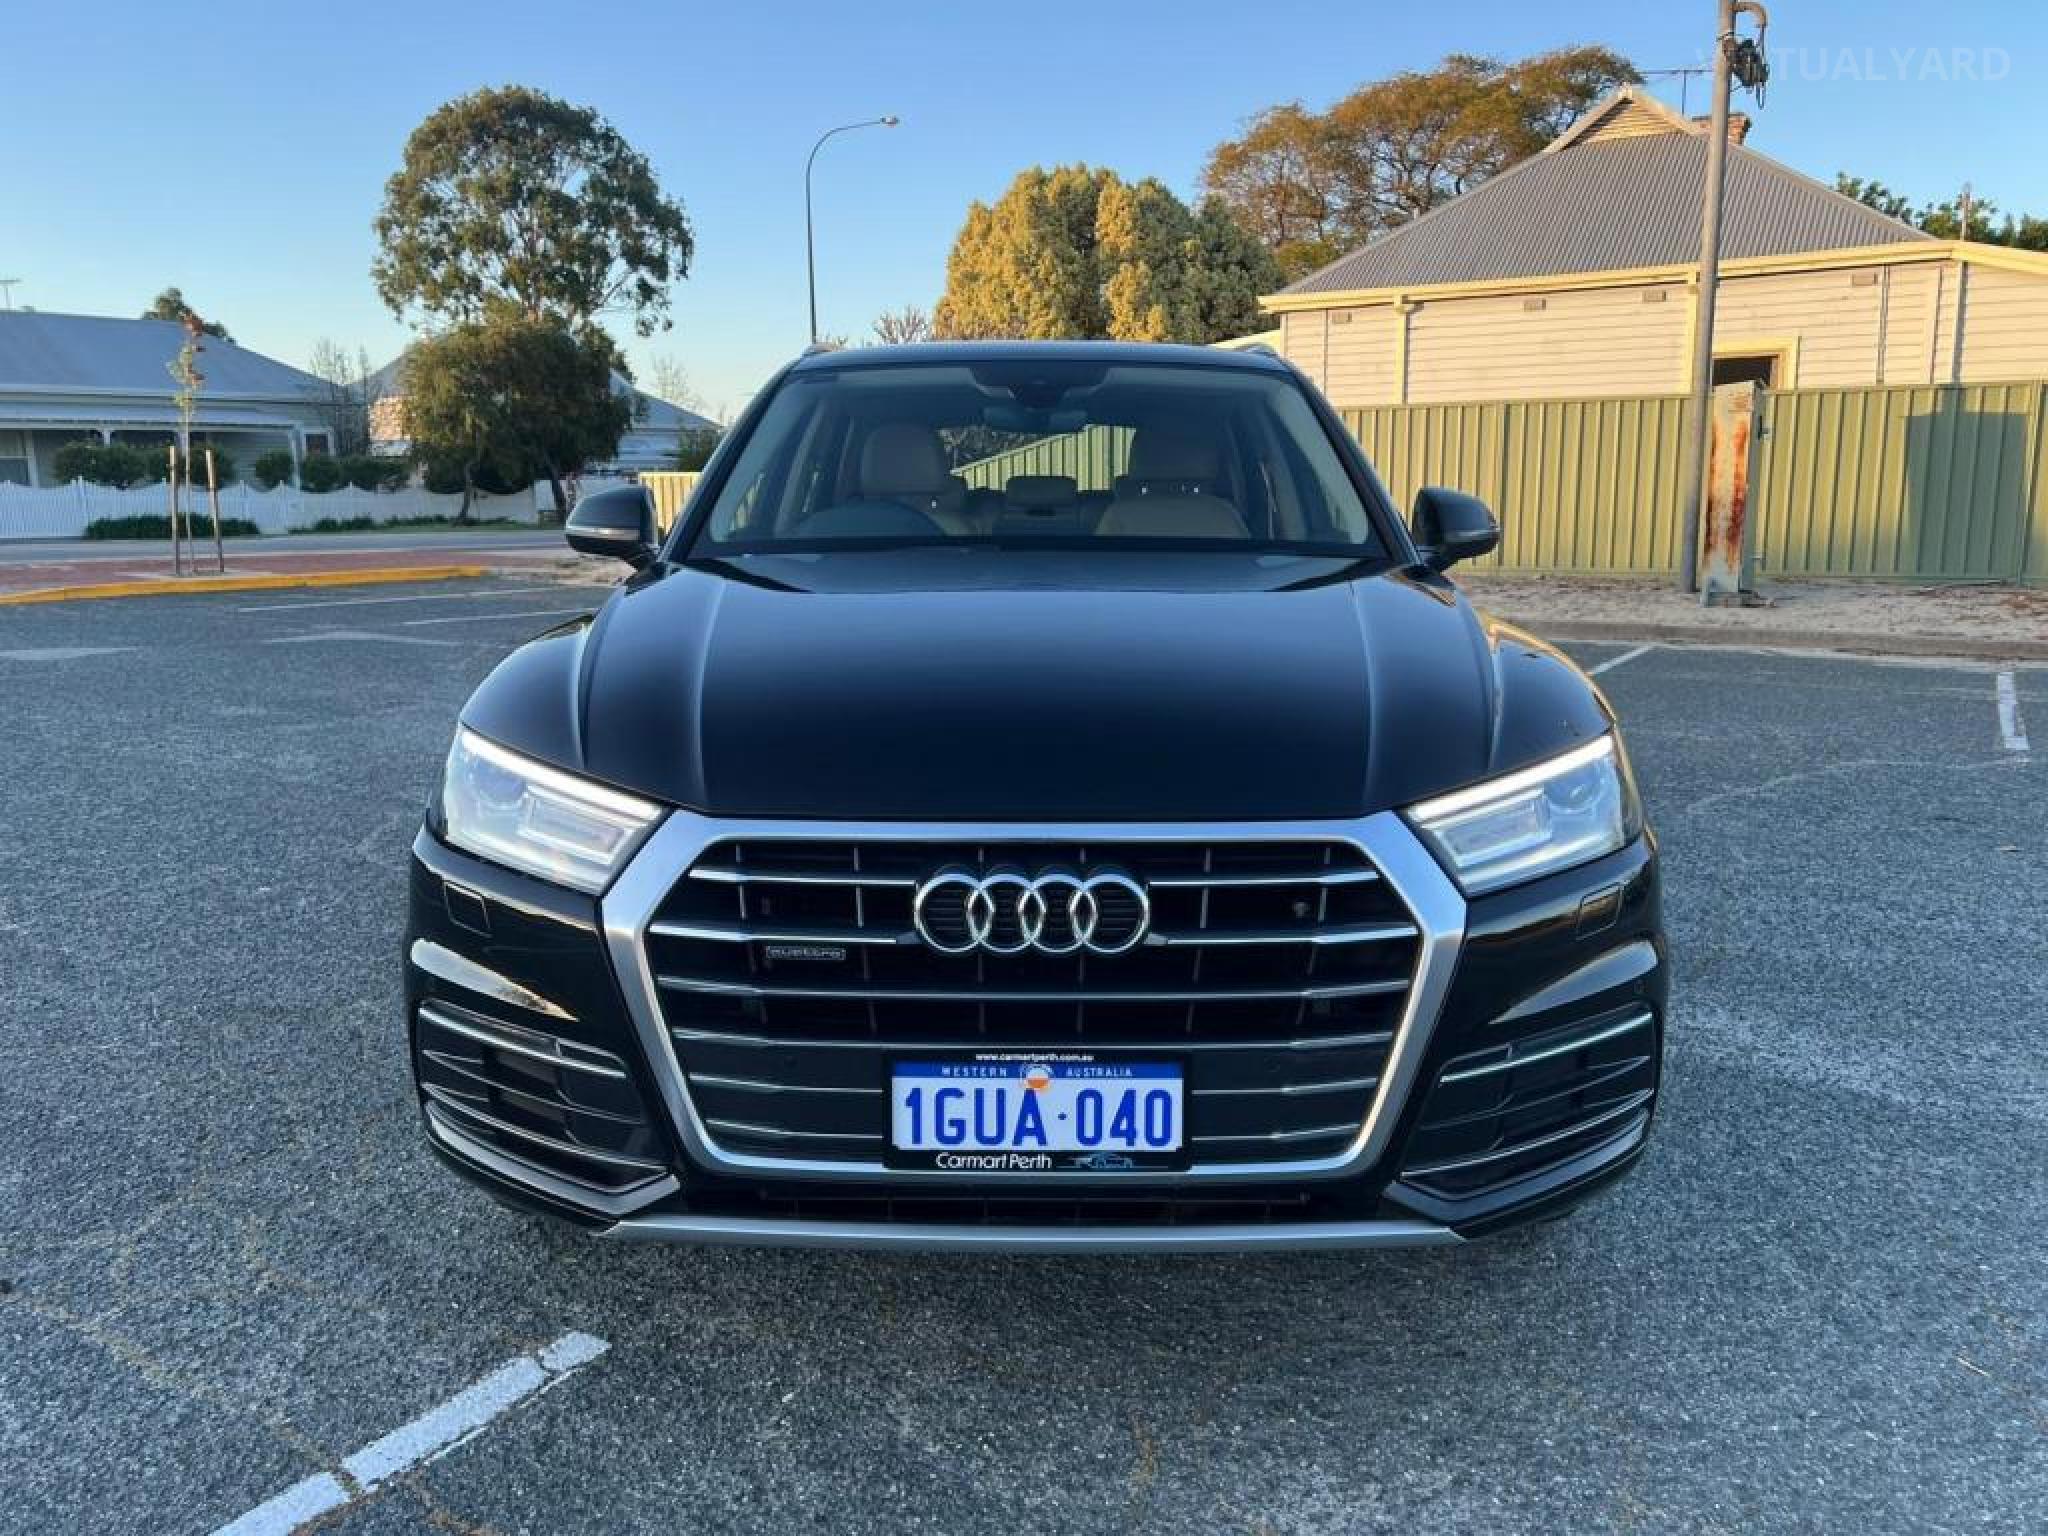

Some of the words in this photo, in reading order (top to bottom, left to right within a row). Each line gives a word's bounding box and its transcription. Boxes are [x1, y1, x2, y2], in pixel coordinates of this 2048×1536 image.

[942, 1066, 1007, 1077] WESTERN
[1066, 1066, 1133, 1077] AUSTRALIA
[936, 1152, 1006, 1169] Carmart
[1010, 1153, 1052, 1169] Perth
